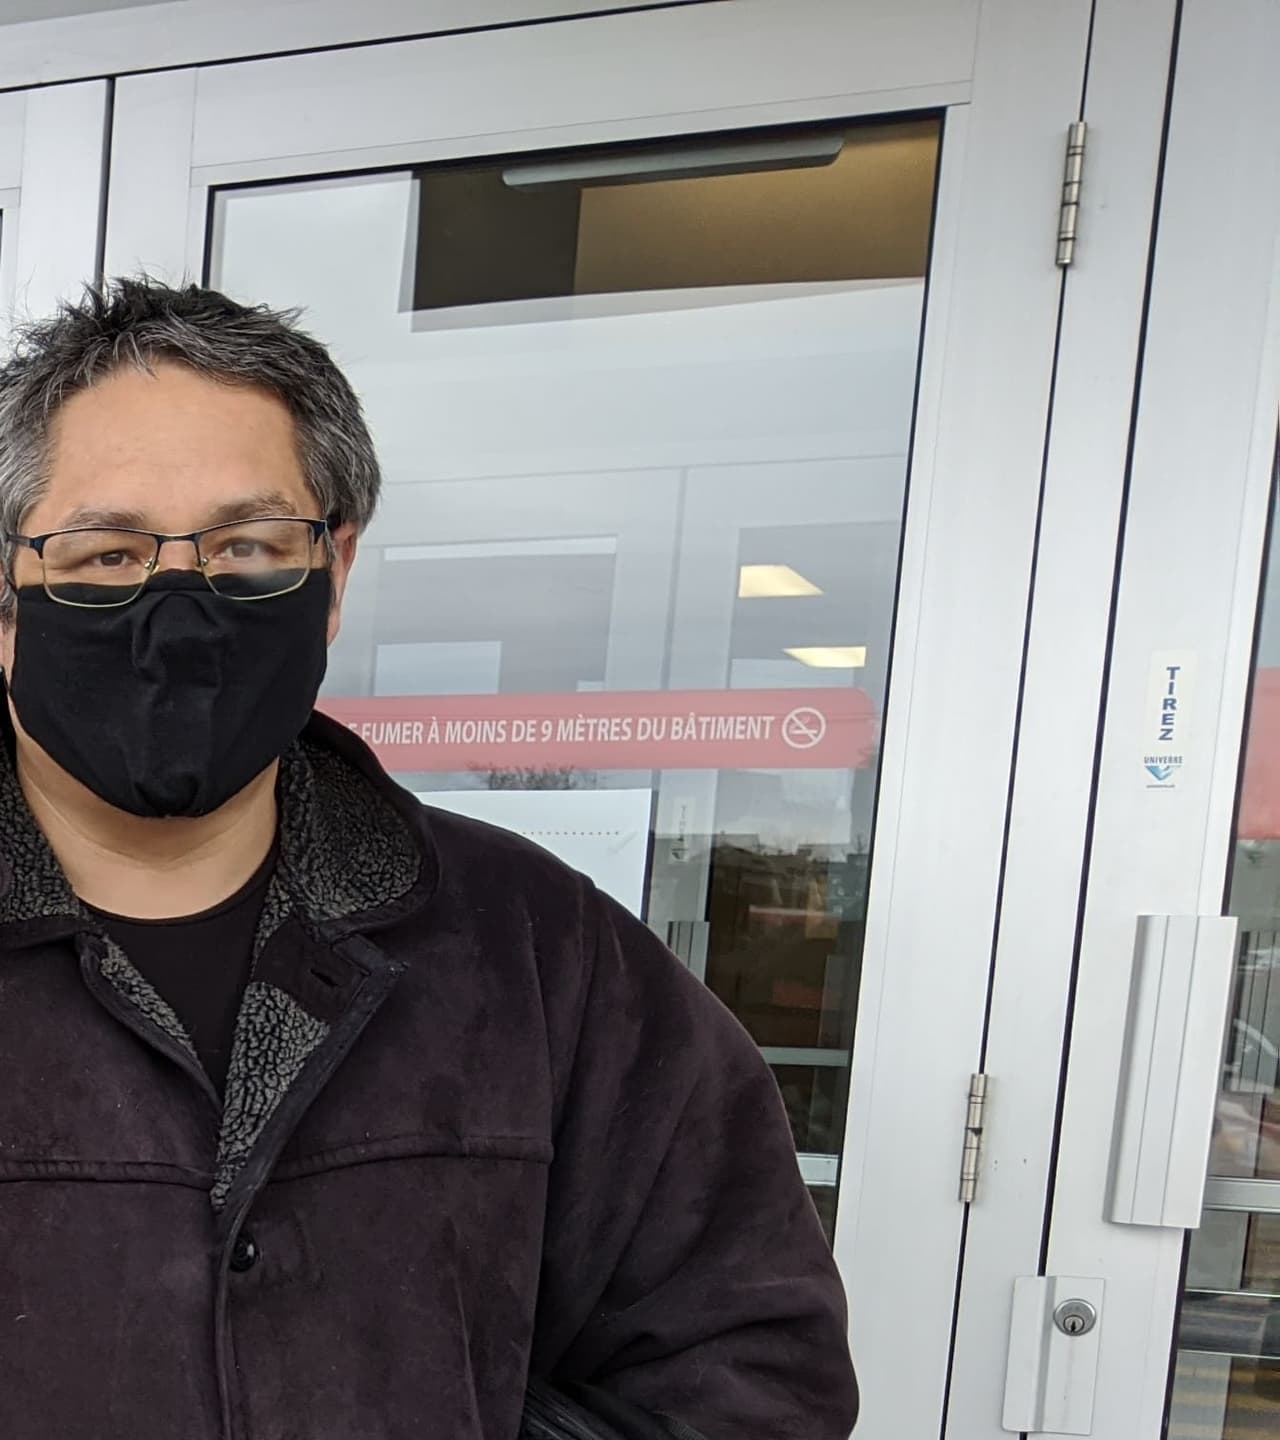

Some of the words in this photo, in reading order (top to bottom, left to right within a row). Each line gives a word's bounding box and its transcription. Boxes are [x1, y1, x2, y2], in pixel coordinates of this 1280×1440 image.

[361, 721, 423, 744] FUMER
[426, 716, 445, 744] À
[445, 719, 507, 744] MOINS
[511, 719, 536, 743] DE
[541, 720, 553, 742] 9
[555, 714, 633, 741] MÈTRES
[636, 716, 666, 741] DU
[670, 712, 775, 741] BÂTIMENT
[1158, 666, 1180, 741] TIREZ
